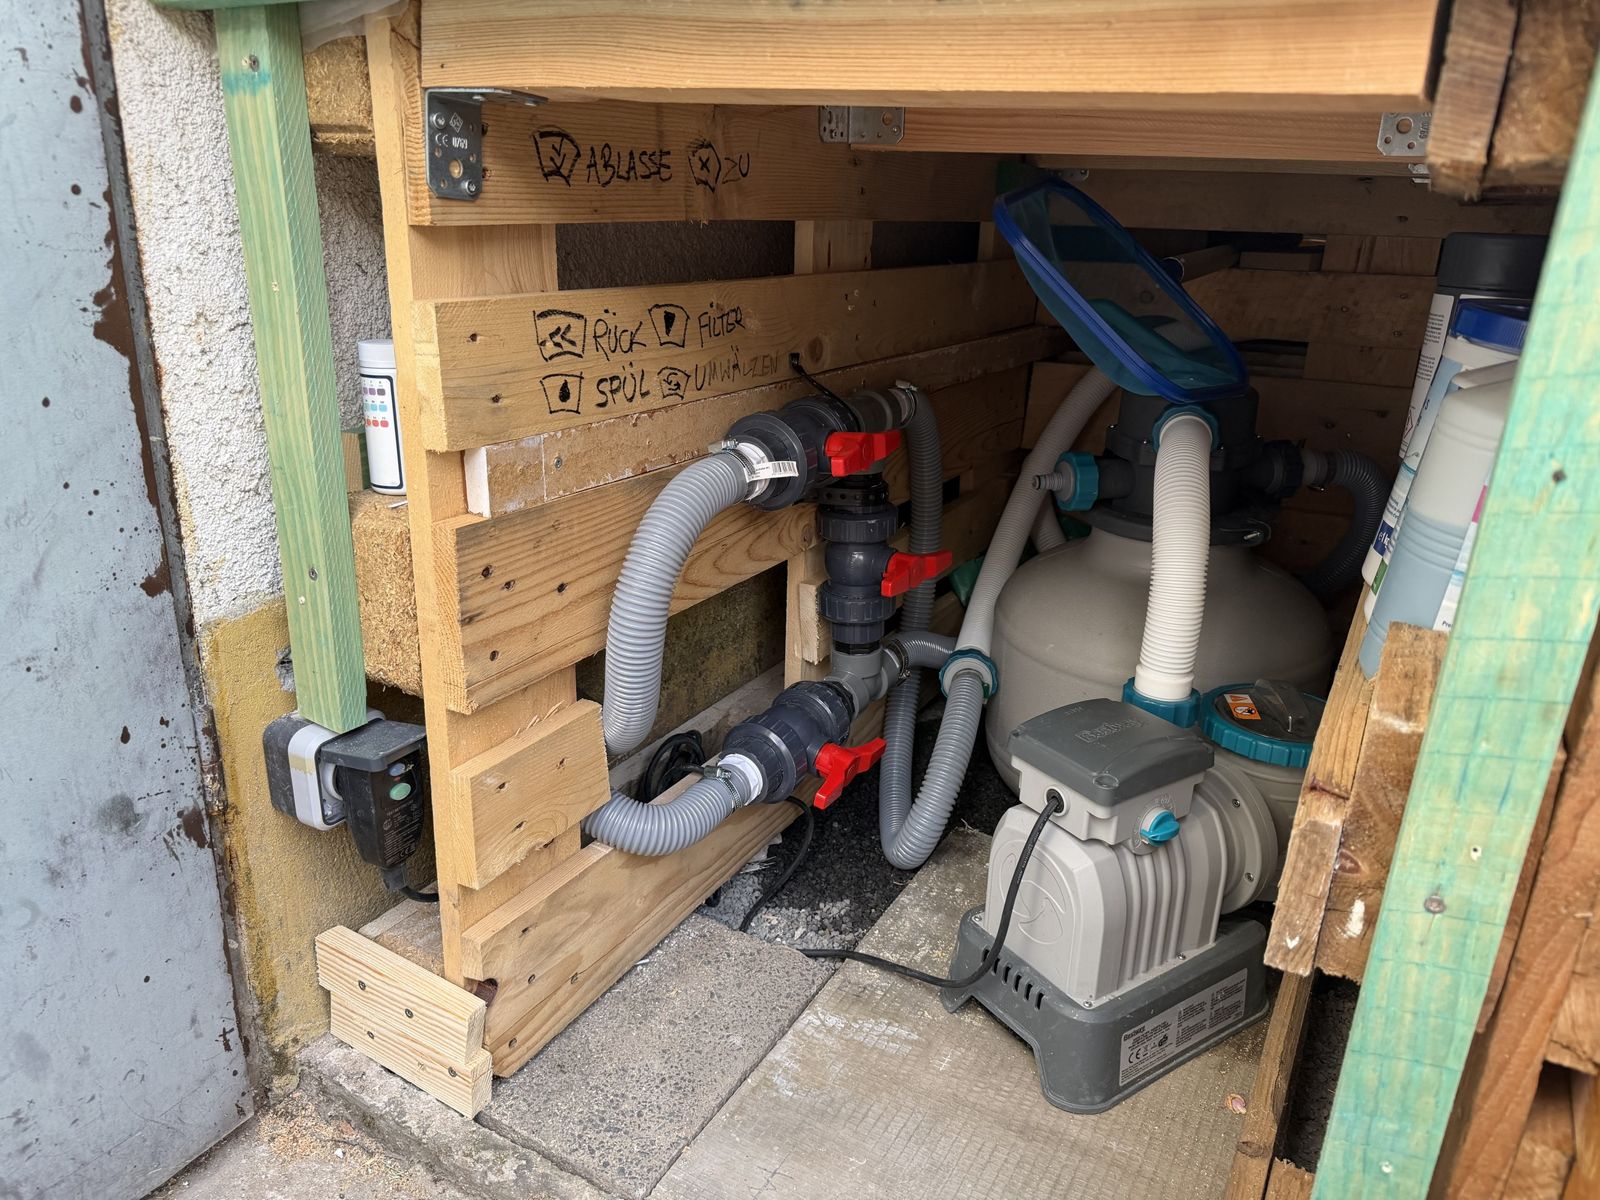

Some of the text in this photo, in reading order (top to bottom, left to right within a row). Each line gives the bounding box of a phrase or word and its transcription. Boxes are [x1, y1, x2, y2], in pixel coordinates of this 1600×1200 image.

[586, 143, 673, 188] ABLASSE
[592, 308, 647, 361] RÜCK
[595, 361, 651, 408] SPÜL
